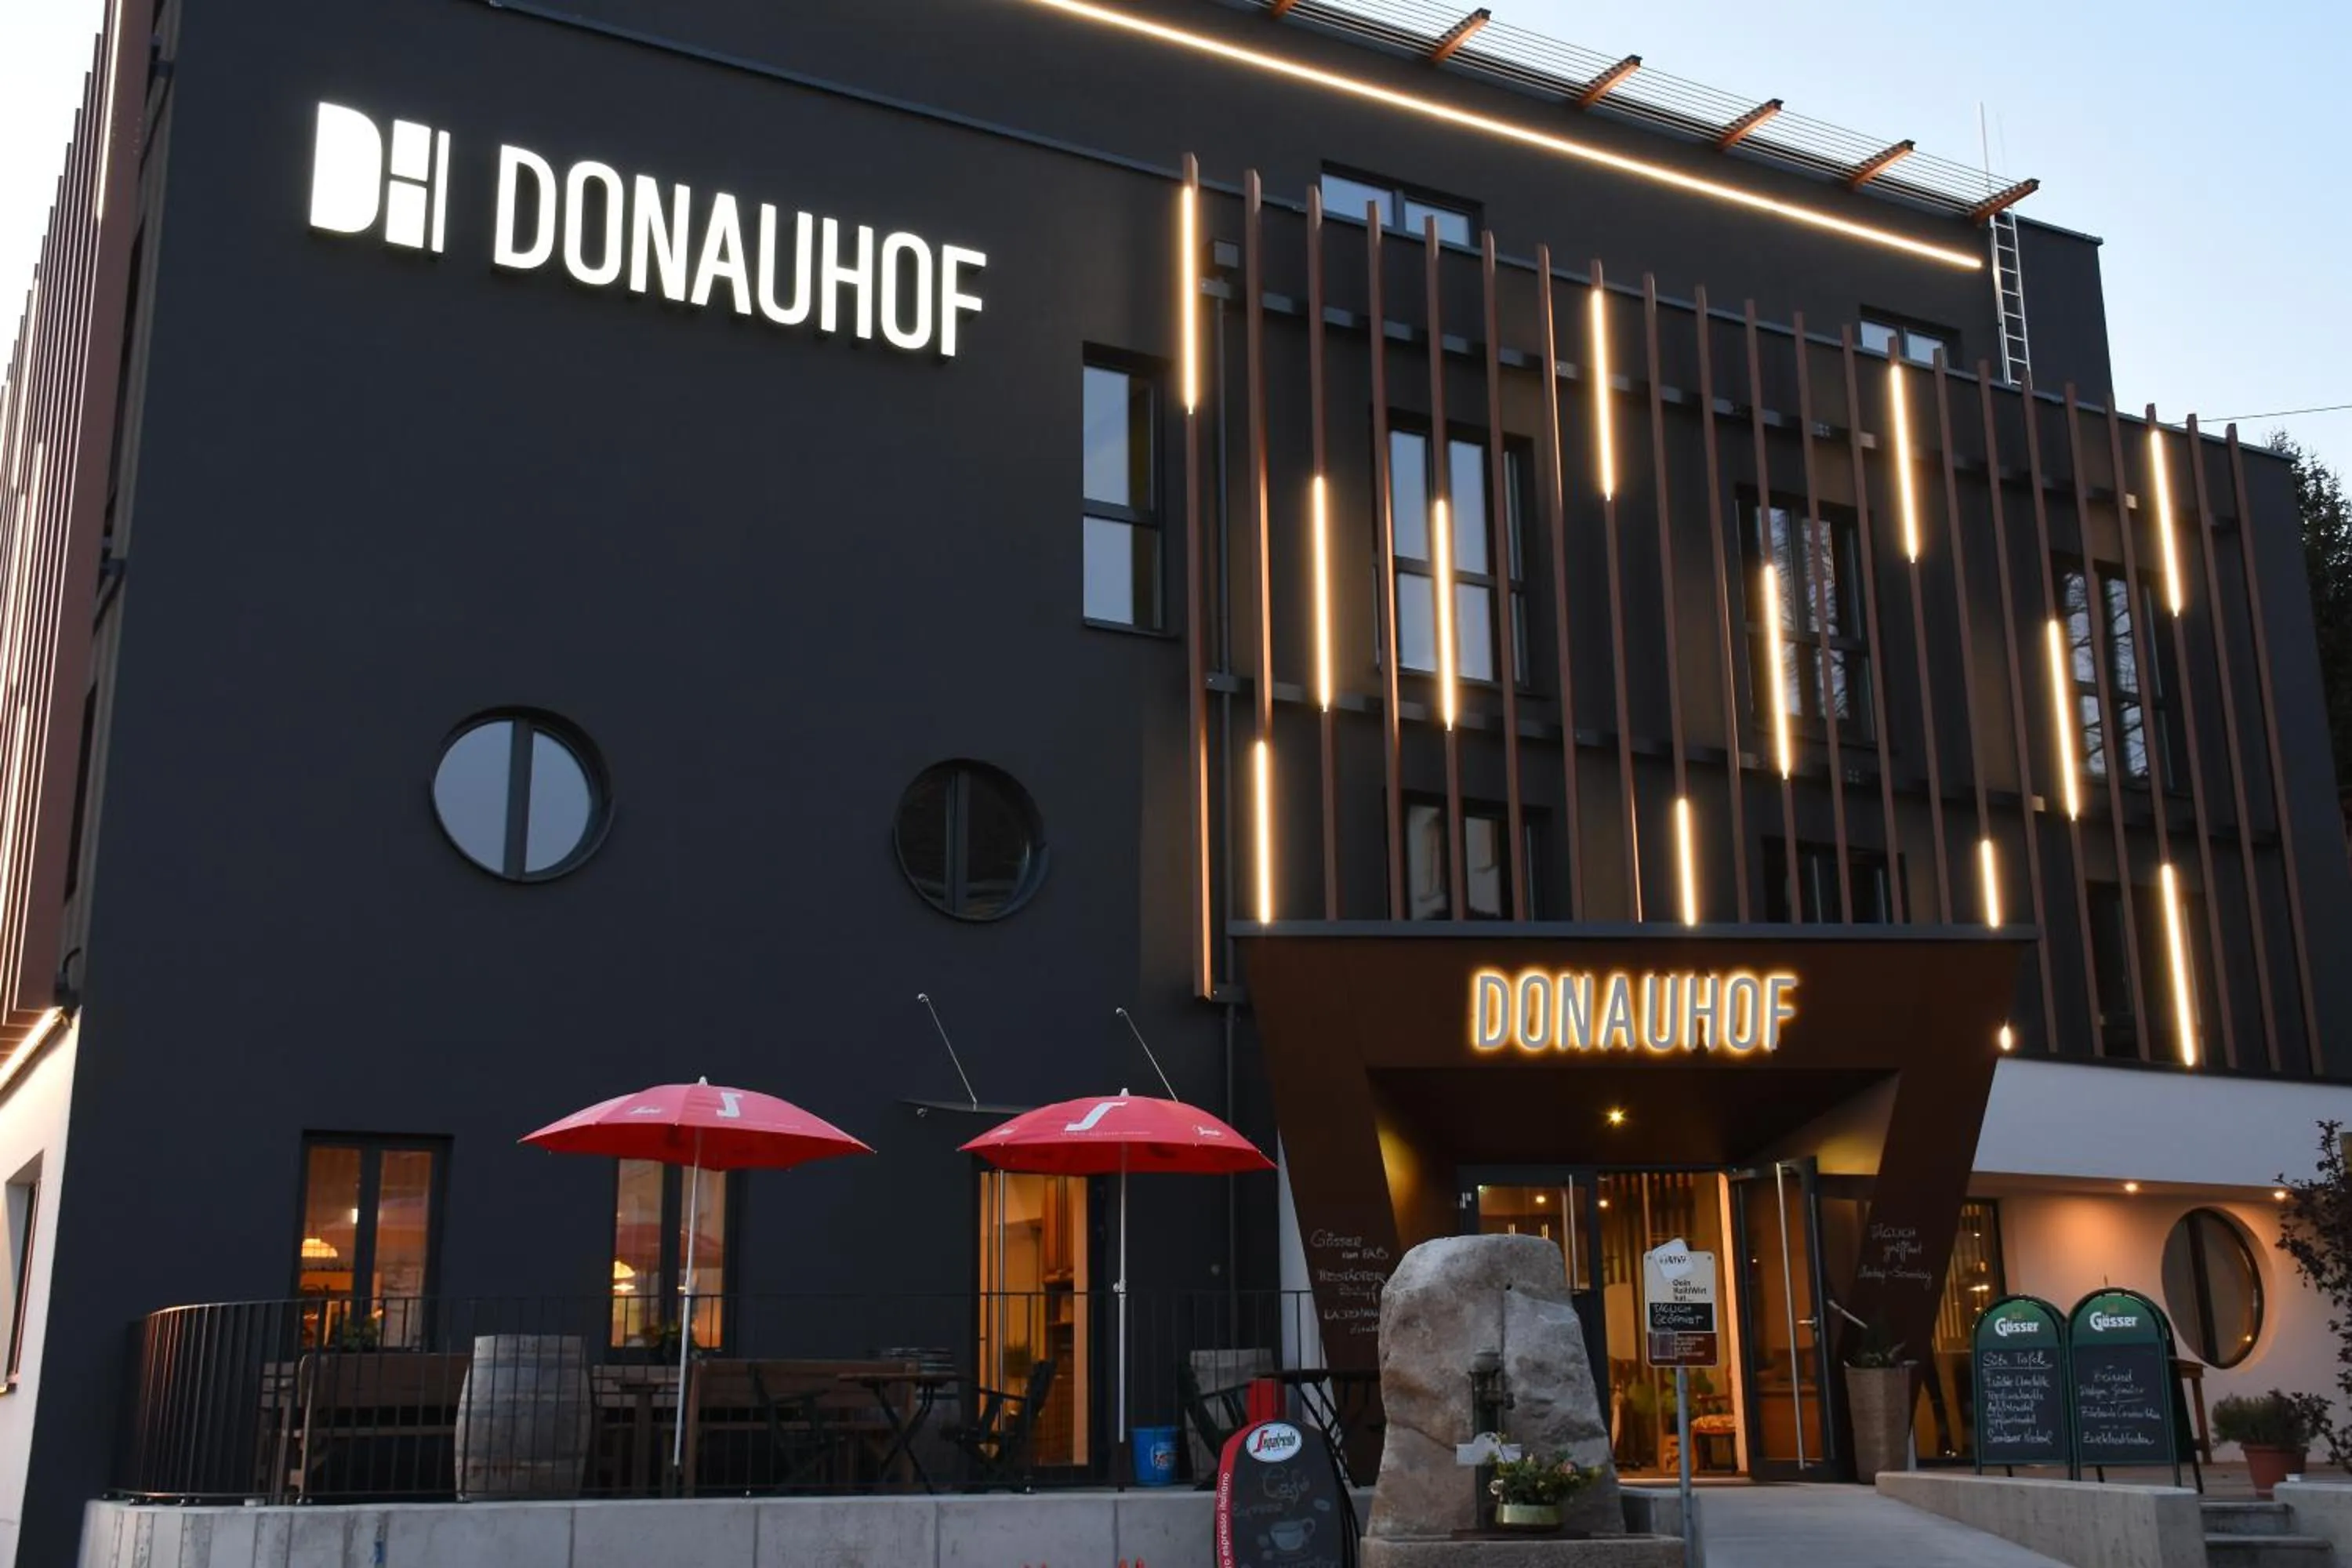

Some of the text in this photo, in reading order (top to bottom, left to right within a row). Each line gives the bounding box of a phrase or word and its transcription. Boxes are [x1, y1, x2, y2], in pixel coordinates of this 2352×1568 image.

[493, 144, 987, 358] DONAUHOF
[1476, 973, 1797, 1051] DONAUHOF
[1994, 1317, 2038, 1337] Gösser
[2089, 1312, 2138, 1331] Gösser
[1219, 1472, 1230, 1511] italiano
[1221, 1513, 1231, 1555] espresso
